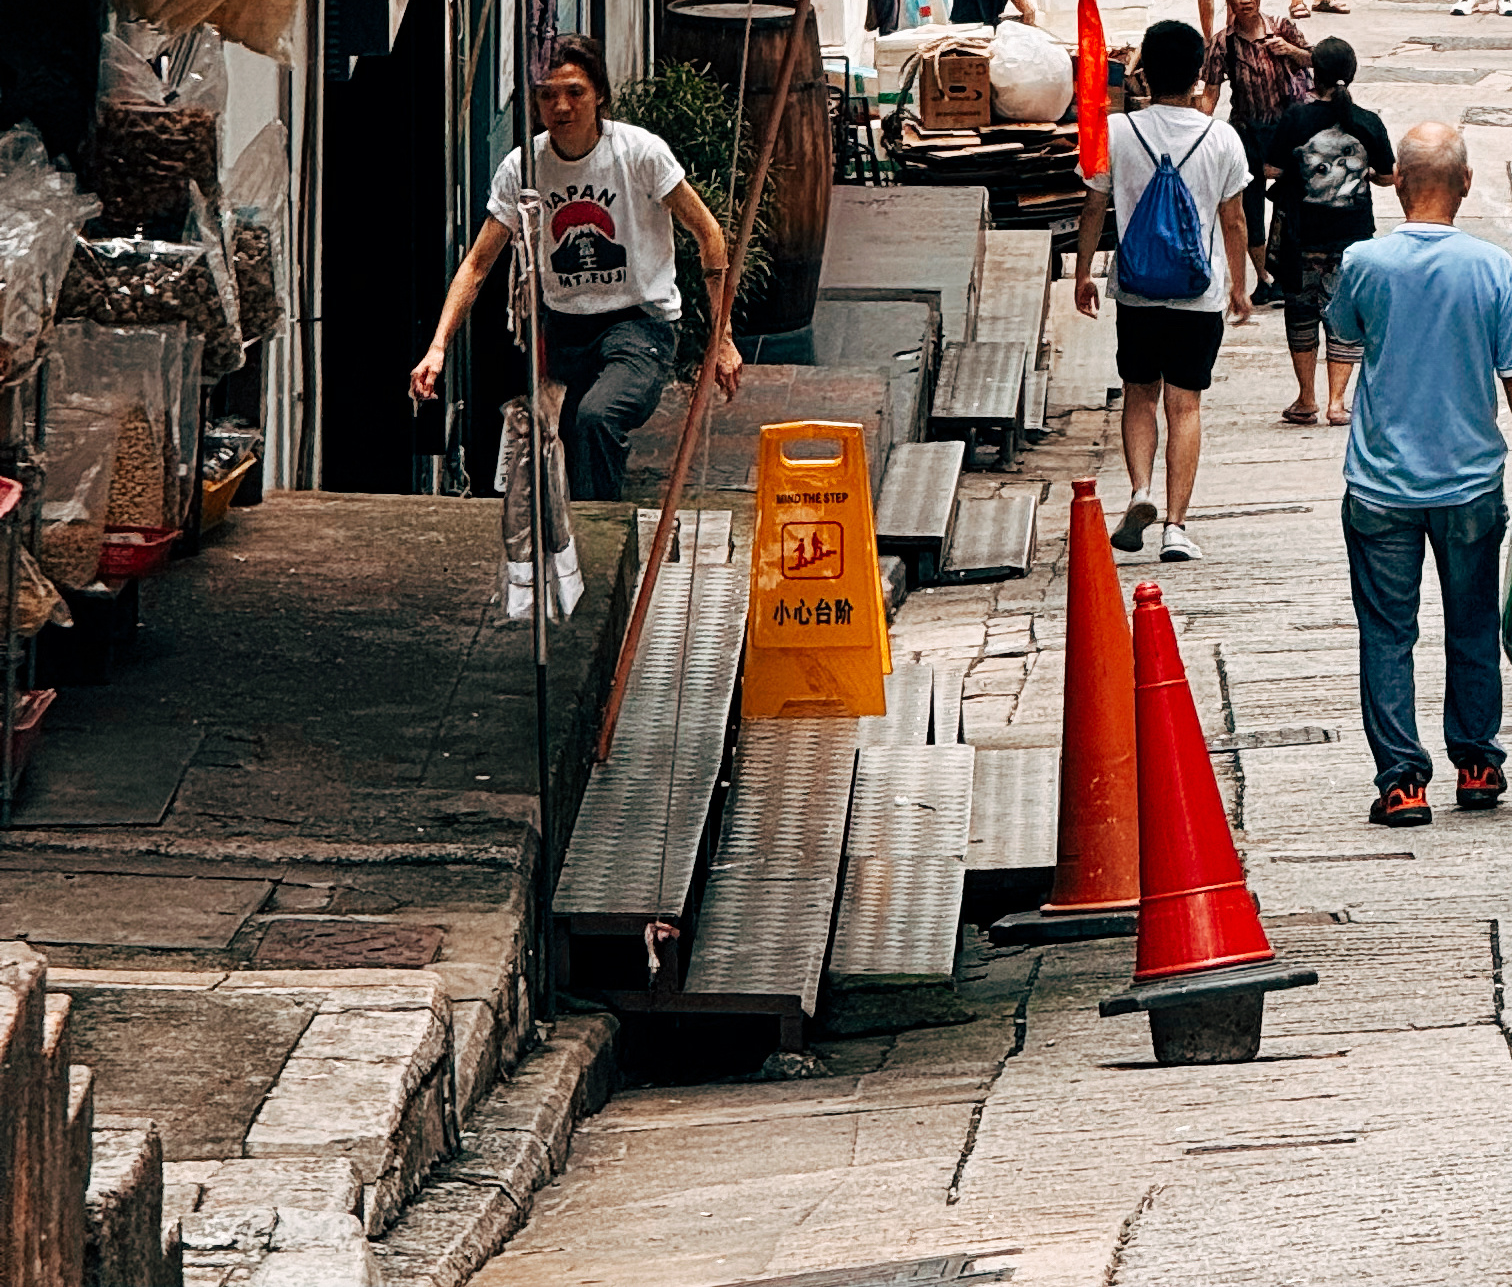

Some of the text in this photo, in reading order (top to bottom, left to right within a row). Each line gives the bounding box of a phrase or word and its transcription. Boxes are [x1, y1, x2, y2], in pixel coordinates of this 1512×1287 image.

[775, 491, 849, 505] MIND THE STEP
[773, 597, 854, 626] 小心台阶
